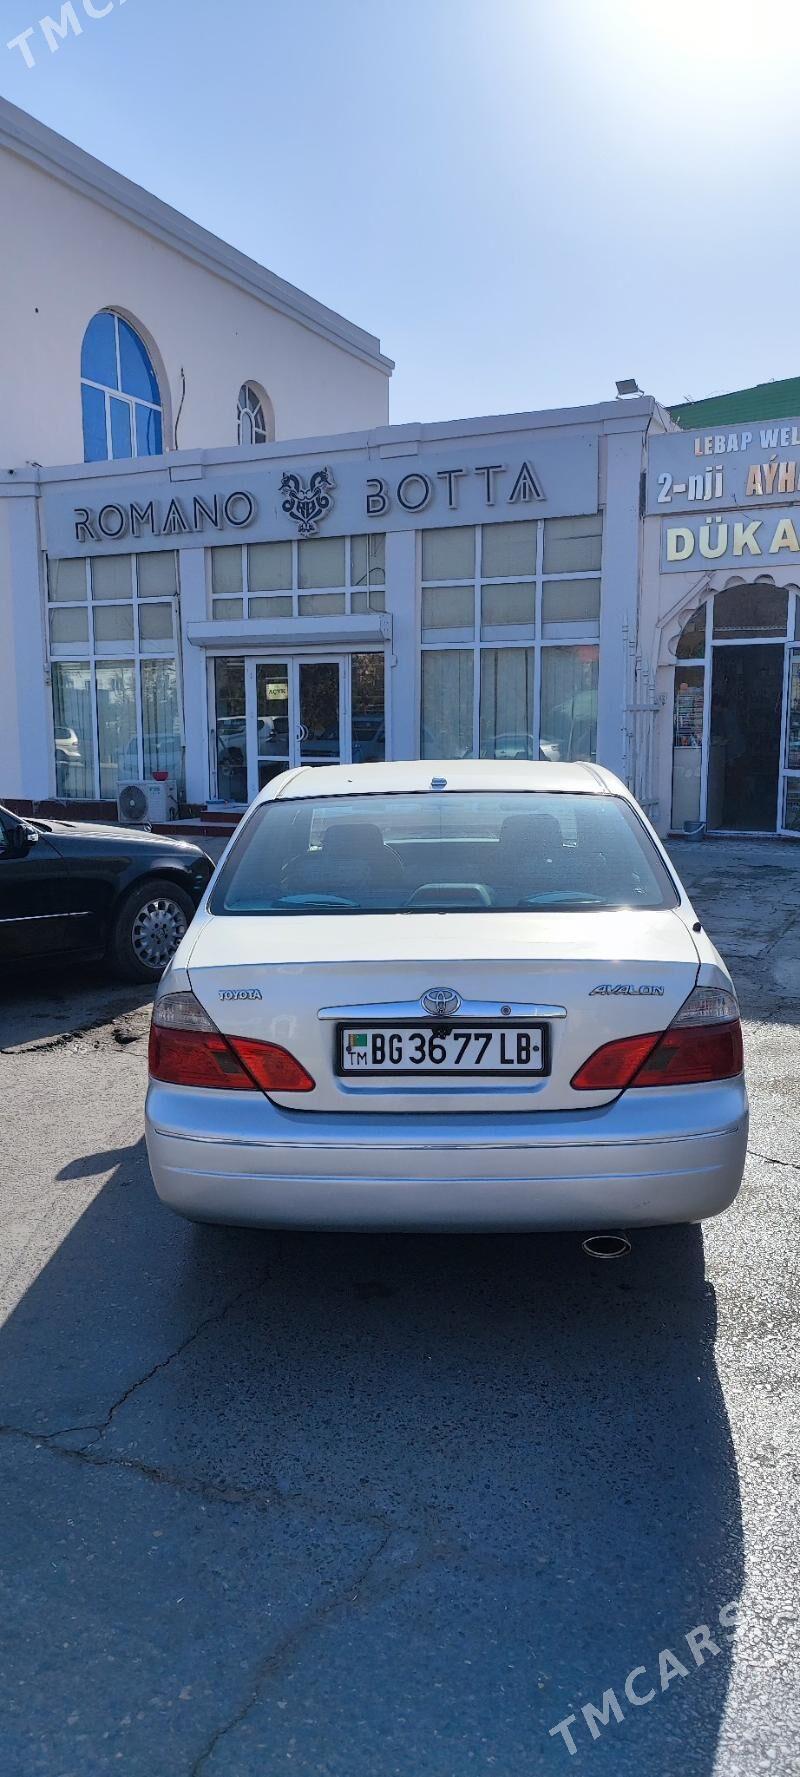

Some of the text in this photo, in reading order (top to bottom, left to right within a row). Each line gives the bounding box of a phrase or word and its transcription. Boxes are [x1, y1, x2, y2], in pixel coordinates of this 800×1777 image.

[694, 432, 752, 456] LEBAP
[657, 454, 800, 503] 2-nji AÝH
[74, 461, 545, 543] ROMANO BOTTA
[218, 988, 263, 1001] TOYOTA
[588, 984, 665, 996] AVALON
[349, 1052, 368, 1065] TM
[371, 1033, 403, 1065] BG
[500, 1033, 531, 1065] LB
